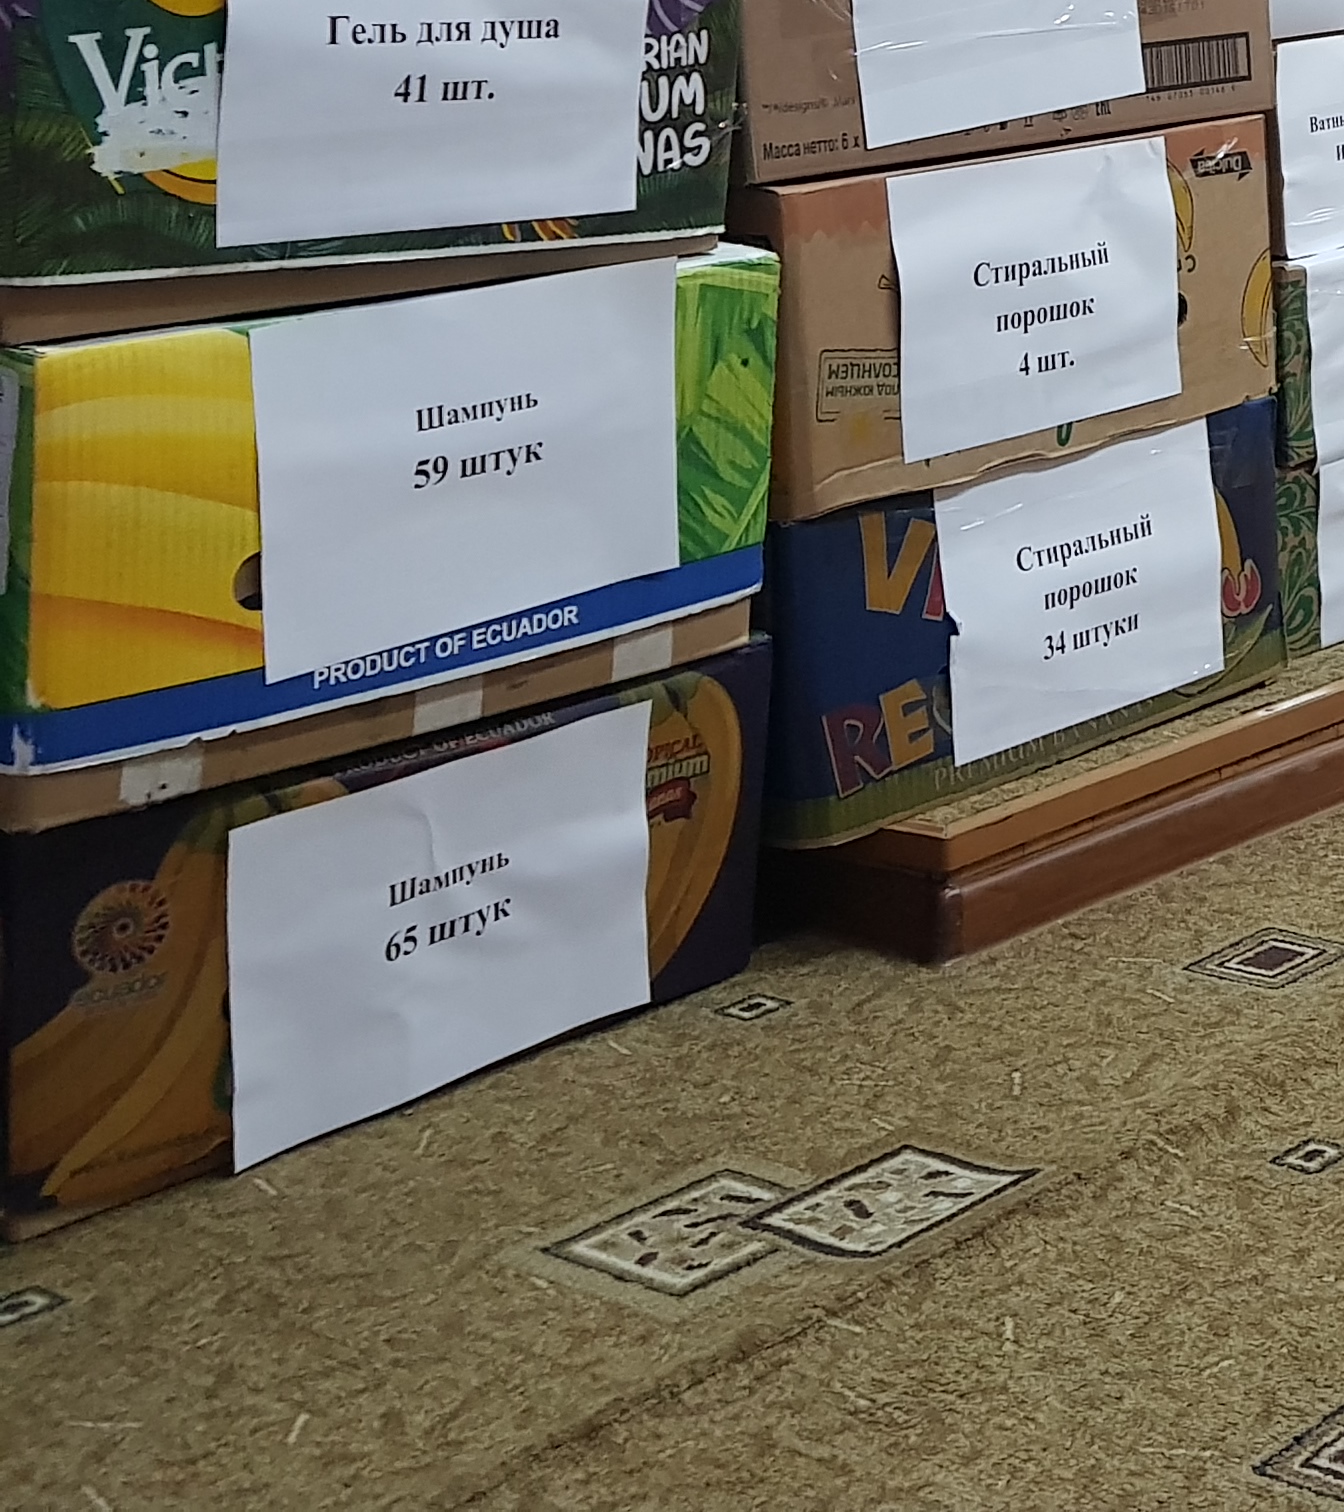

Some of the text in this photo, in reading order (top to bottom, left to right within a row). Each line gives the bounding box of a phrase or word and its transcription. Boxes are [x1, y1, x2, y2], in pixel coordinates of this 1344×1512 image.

[327, 15, 560, 49] Гель для душа
[393, 74, 495, 103] 41 шт.
[762, 141, 802, 161] Масса
[802, 138, 839, 156] нетто:
[973, 241, 1109, 287] Стиральный
[996, 297, 1095, 334] порошок
[827, 361, 898, 381] СОЛНЦЕМ
[1018, 350, 1075, 377] 4 шт.
[825, 384, 874, 397] ЮЖНЫМ
[416, 392, 539, 432] Шампунь
[413, 441, 543, 489] 59 штук
[1016, 513, 1152, 573] Стиральный
[1044, 567, 1138, 611] порошок
[313, 604, 580, 689] PRODUCT OF ECUADOR
[1043, 613, 1138, 661] 34 штуки
[389, 852, 511, 908] Шампунь
[385, 898, 511, 962] 65 штук
